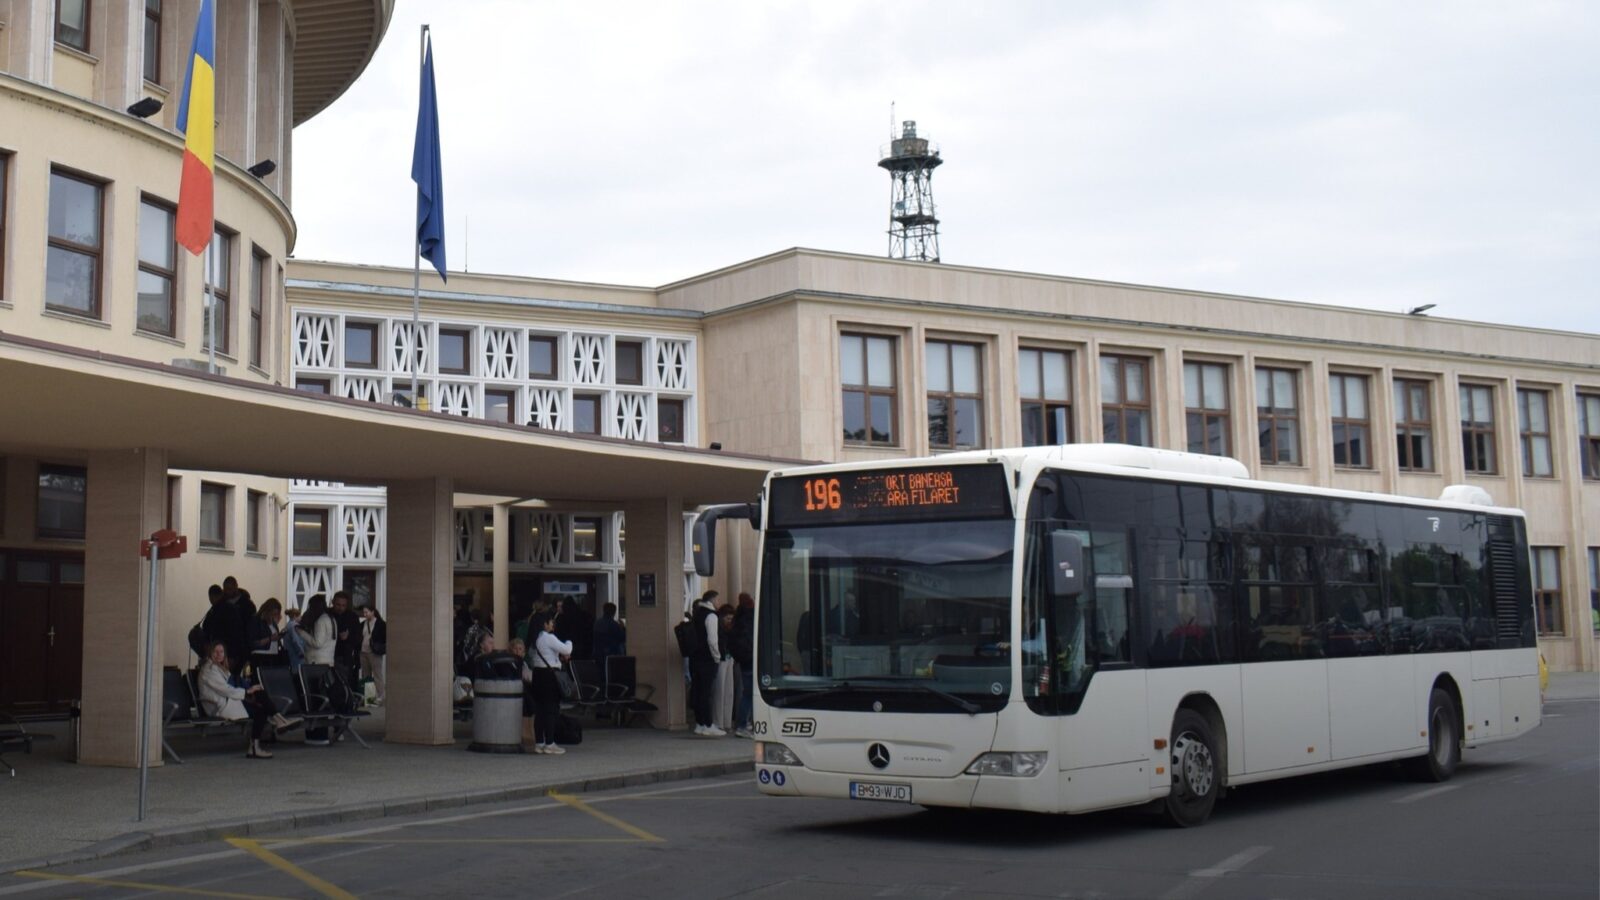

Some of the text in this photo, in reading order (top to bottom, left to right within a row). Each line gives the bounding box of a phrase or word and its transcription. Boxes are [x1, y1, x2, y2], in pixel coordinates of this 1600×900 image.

[908, 472, 953, 490] BANEASA
[804, 478, 841, 511] 196
[911, 487, 960, 506] FILARET
[752, 720, 768, 735] 03
[781, 721, 813, 734] STB
[858, 784, 866, 797] B
[868, 785, 881, 798] 93
